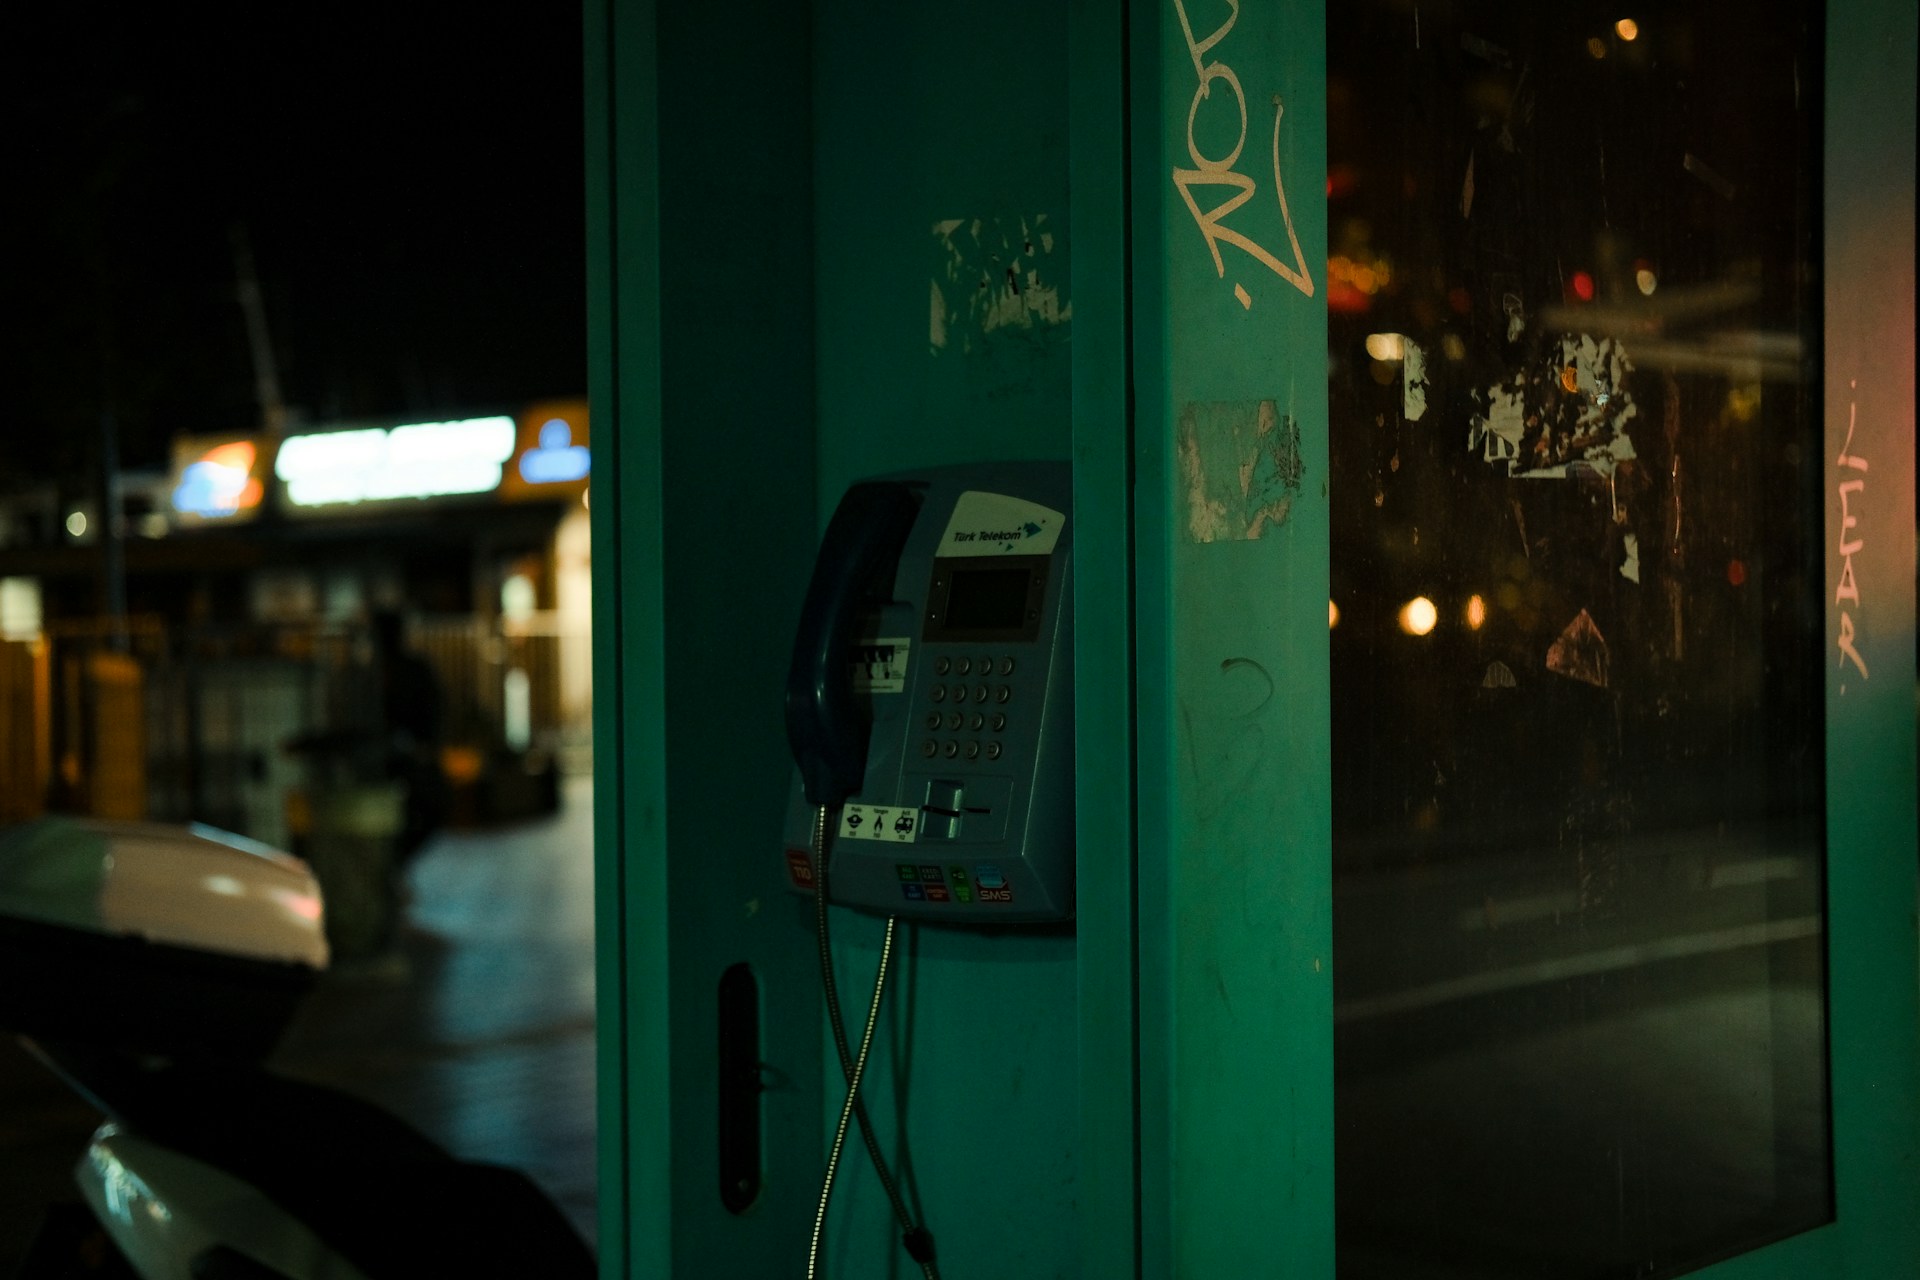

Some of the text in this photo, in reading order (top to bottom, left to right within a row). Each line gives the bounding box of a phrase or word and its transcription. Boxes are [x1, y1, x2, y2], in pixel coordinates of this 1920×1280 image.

[954, 531, 1021, 542] Türk Telekom
[979, 890, 1012, 901] SMS
